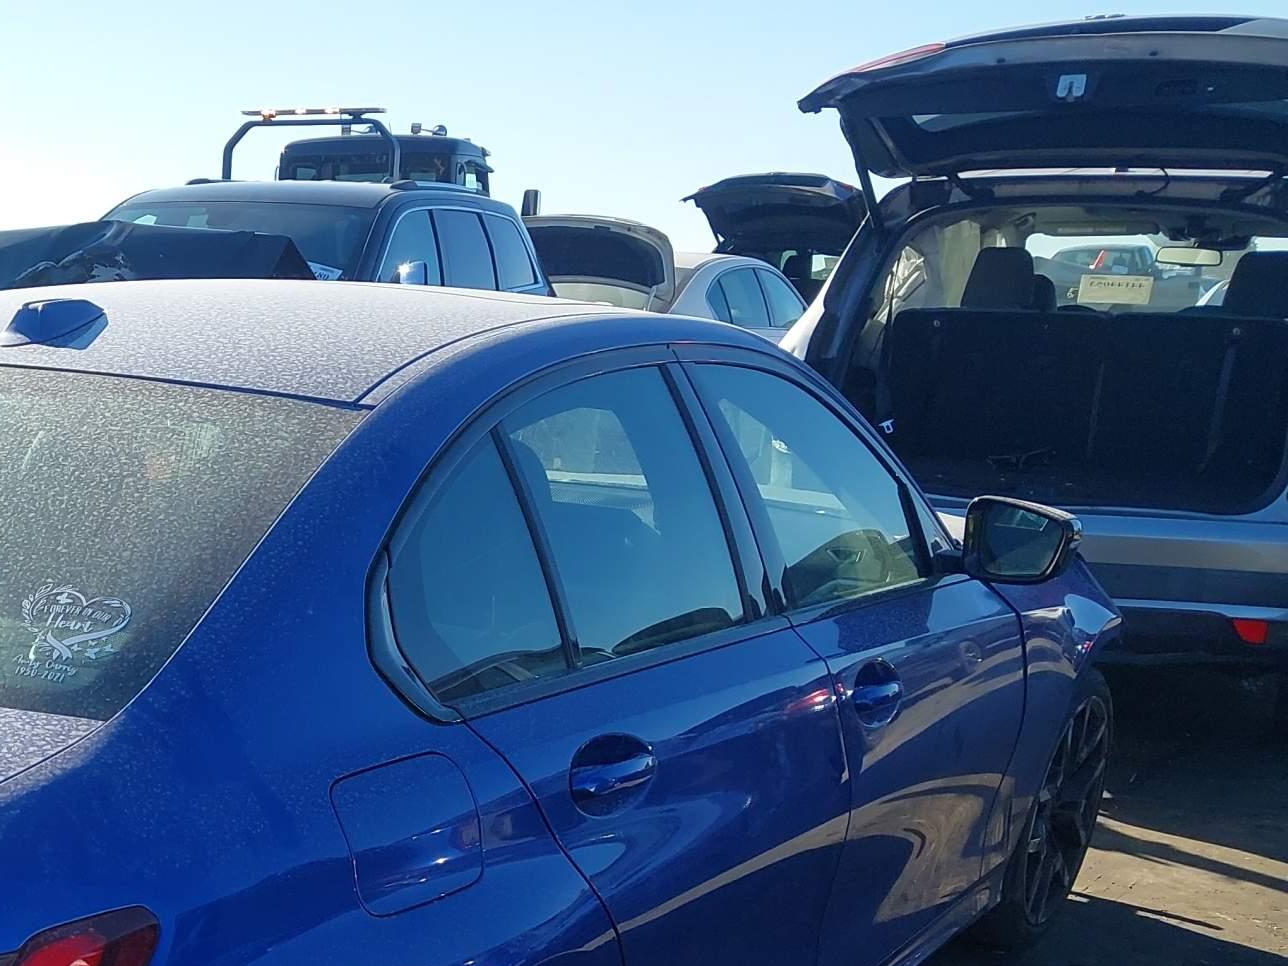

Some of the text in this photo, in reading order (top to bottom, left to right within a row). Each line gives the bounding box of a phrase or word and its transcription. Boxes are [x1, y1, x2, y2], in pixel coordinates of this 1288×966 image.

[42, 604, 112, 623] FOREVER IN OUR
[45, 612, 94, 633] Heart
